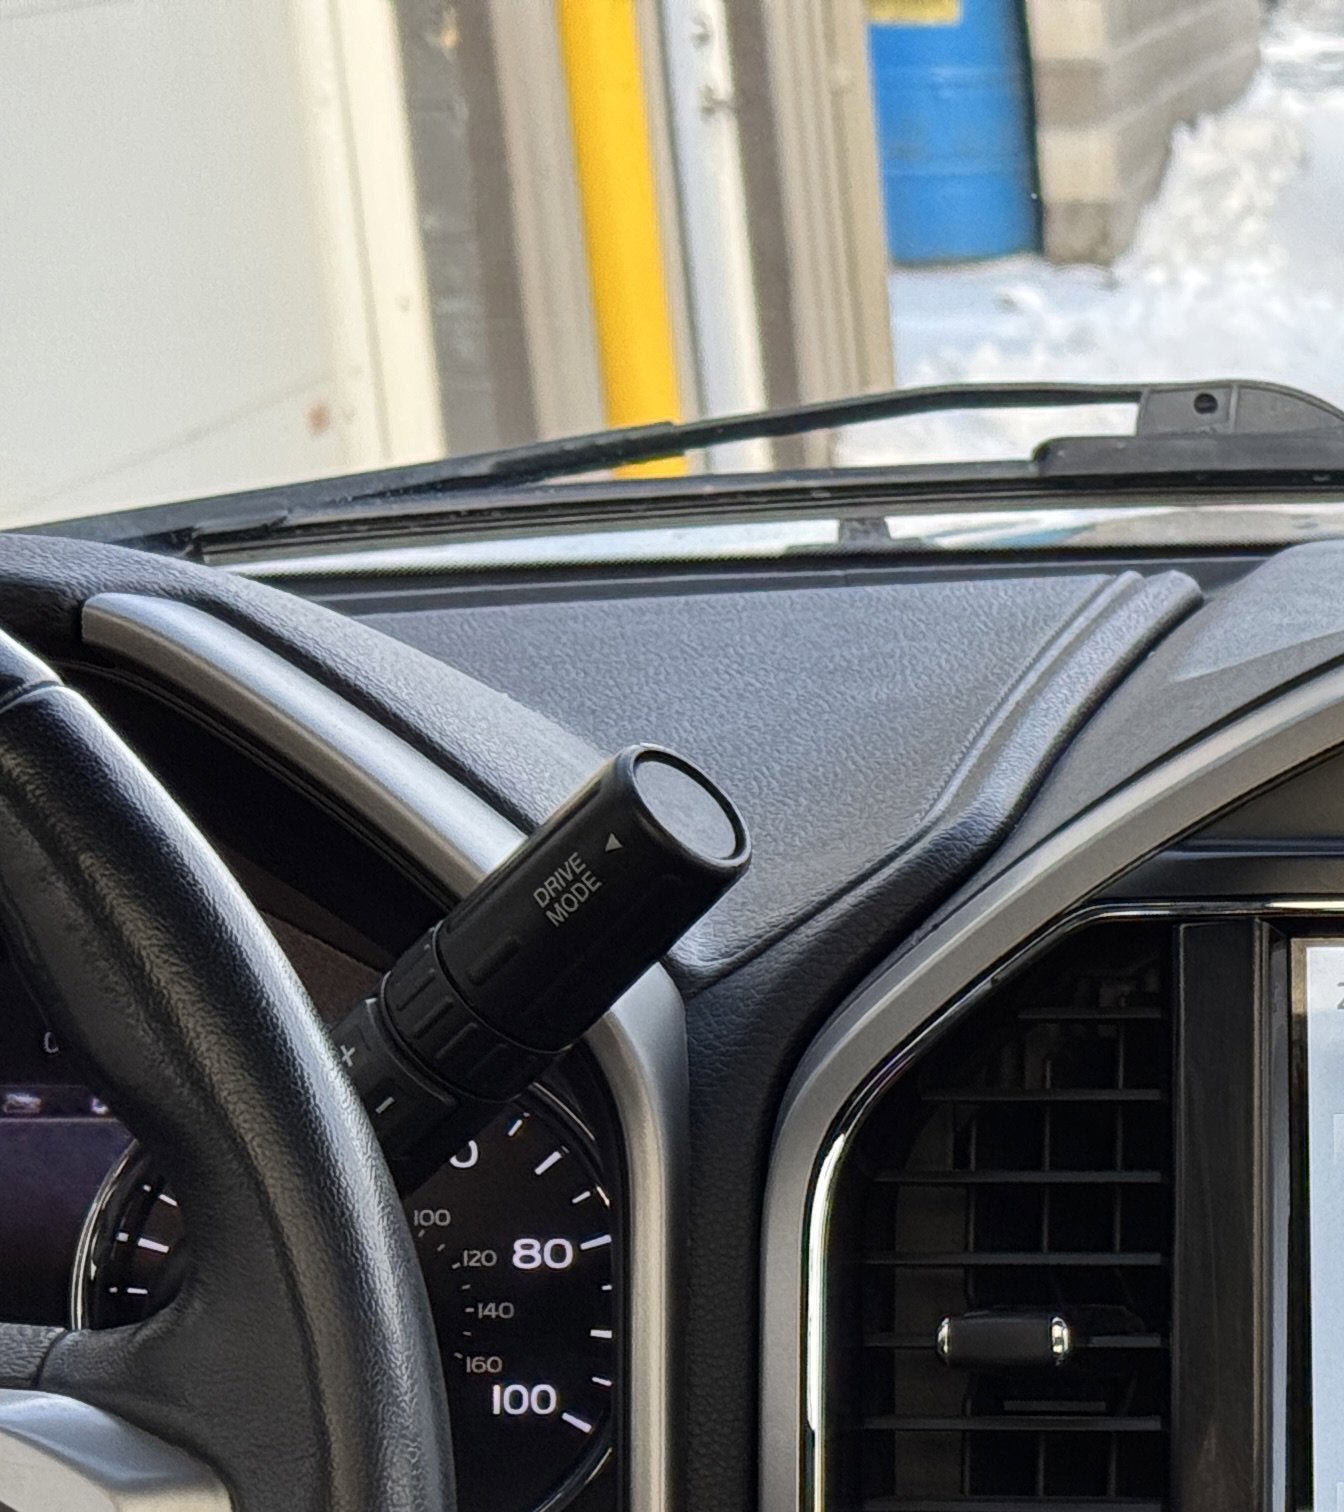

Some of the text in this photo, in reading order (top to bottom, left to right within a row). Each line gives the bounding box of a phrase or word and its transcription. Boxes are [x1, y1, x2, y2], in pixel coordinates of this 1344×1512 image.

[533, 852, 586, 908] DRIVE
[546, 871, 602, 927] MODE
[413, 1209, 451, 1226] 100
[463, 1249, 498, 1267] 120
[512, 1238, 573, 1269] 80
[478, 1302, 515, 1319] 140
[466, 1356, 503, 1373] 160
[492, 1384, 557, 1415] 100
